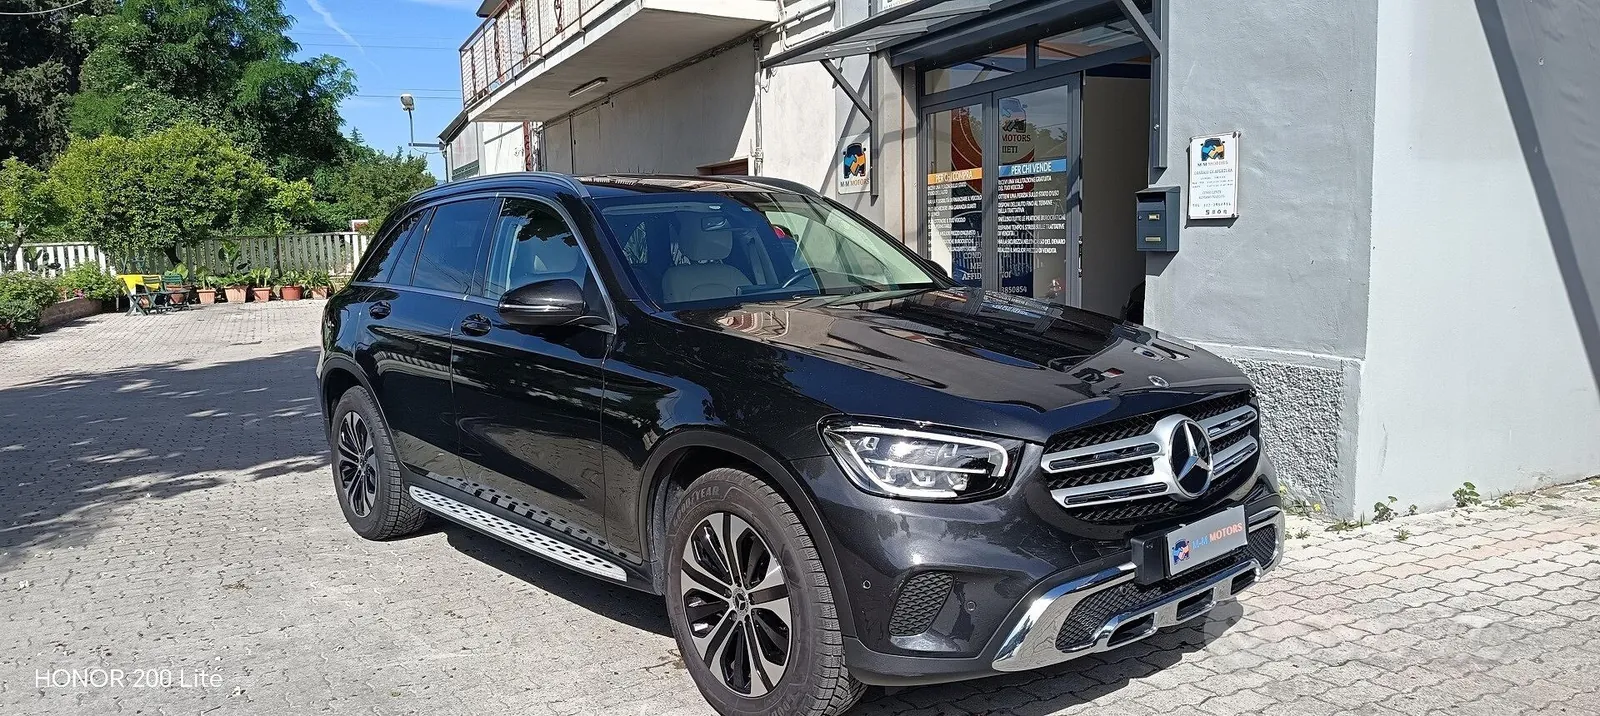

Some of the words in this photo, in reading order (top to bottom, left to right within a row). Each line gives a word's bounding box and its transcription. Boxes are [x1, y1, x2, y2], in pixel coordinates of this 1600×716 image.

[1011, 166, 1021, 174] PER
[1022, 164, 1032, 174] CHI
[1032, 162, 1051, 172] VENDE
[1192, 535, 1208, 550] M-M
[1209, 522, 1243, 542] MOTORS
